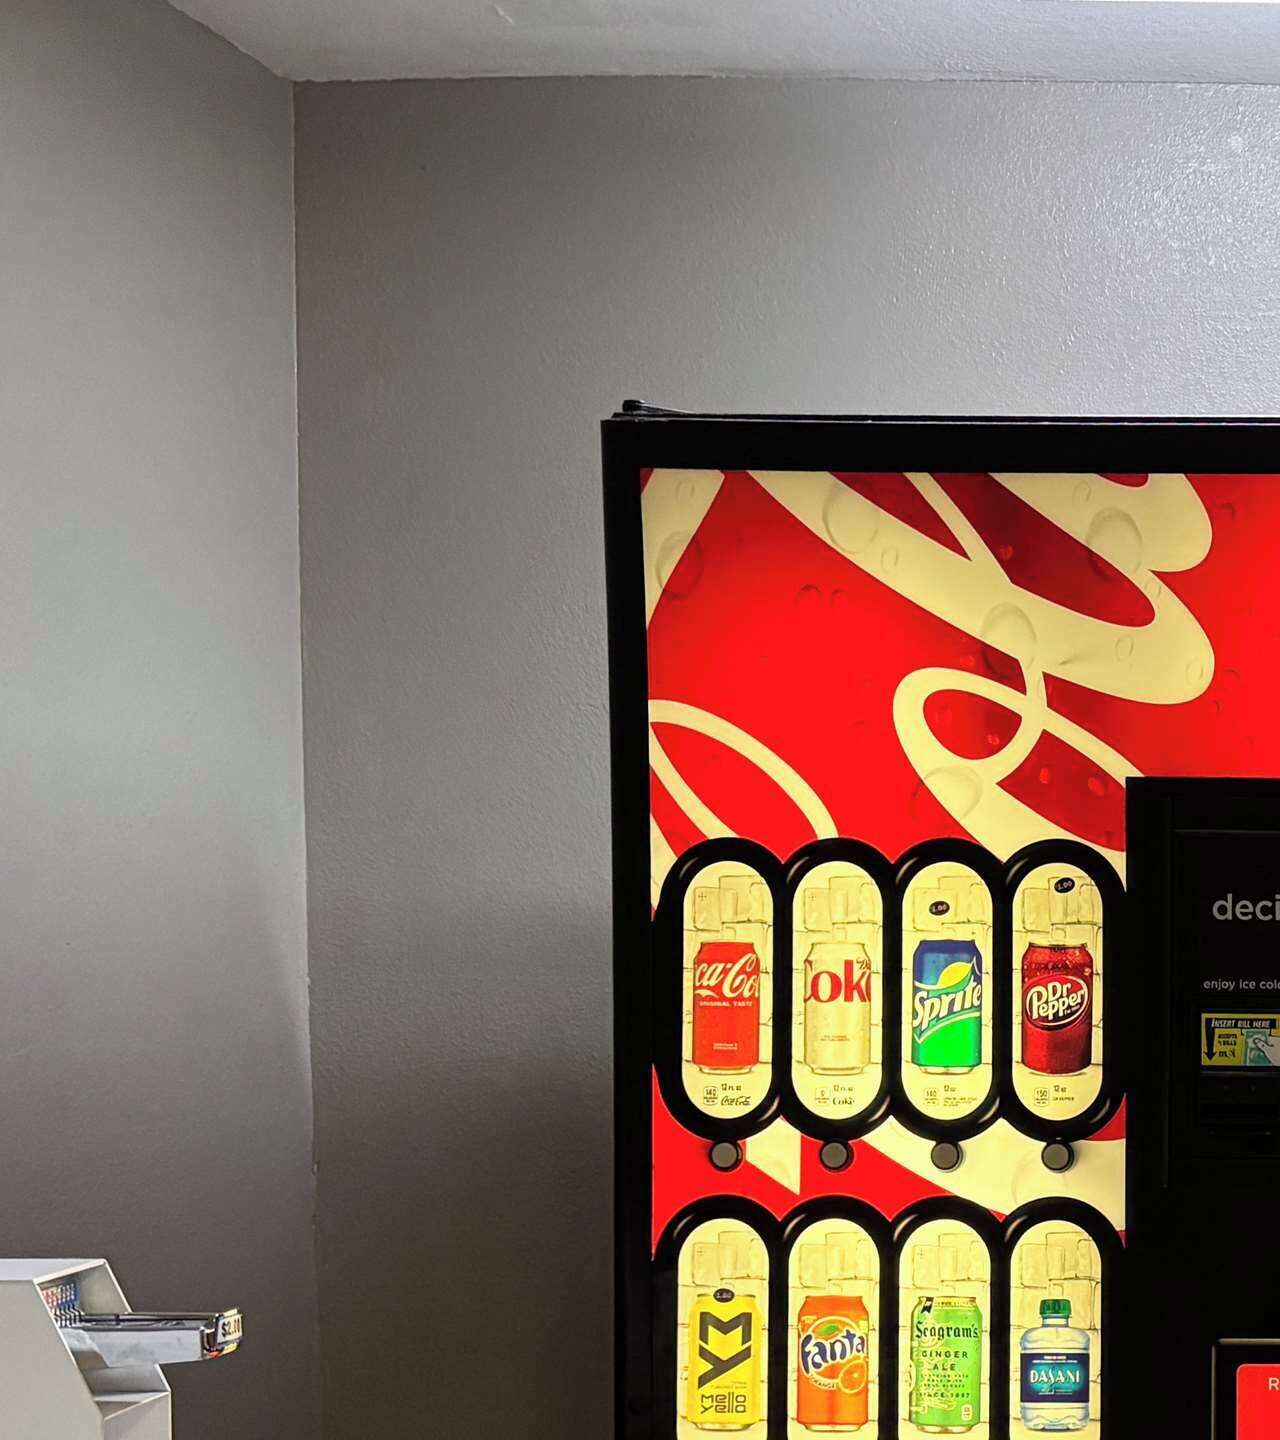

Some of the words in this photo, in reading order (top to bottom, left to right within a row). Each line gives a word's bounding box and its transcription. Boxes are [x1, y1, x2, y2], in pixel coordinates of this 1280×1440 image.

[1050, 981, 1072, 998] Dr
[1203, 979, 1236, 991] enjoy
[1239, 979, 1256, 990] ice
[912, 977, 982, 1031] Sprite
[1031, 985, 1086, 1020] Pepper
[915, 1320, 979, 1341] Seagram's
[801, 1328, 866, 1375] Fanta
[922, 1350, 969, 1359] GINGER
[932, 1363, 957, 1371] ALE
[1030, 1368, 1080, 1384] DASANI
